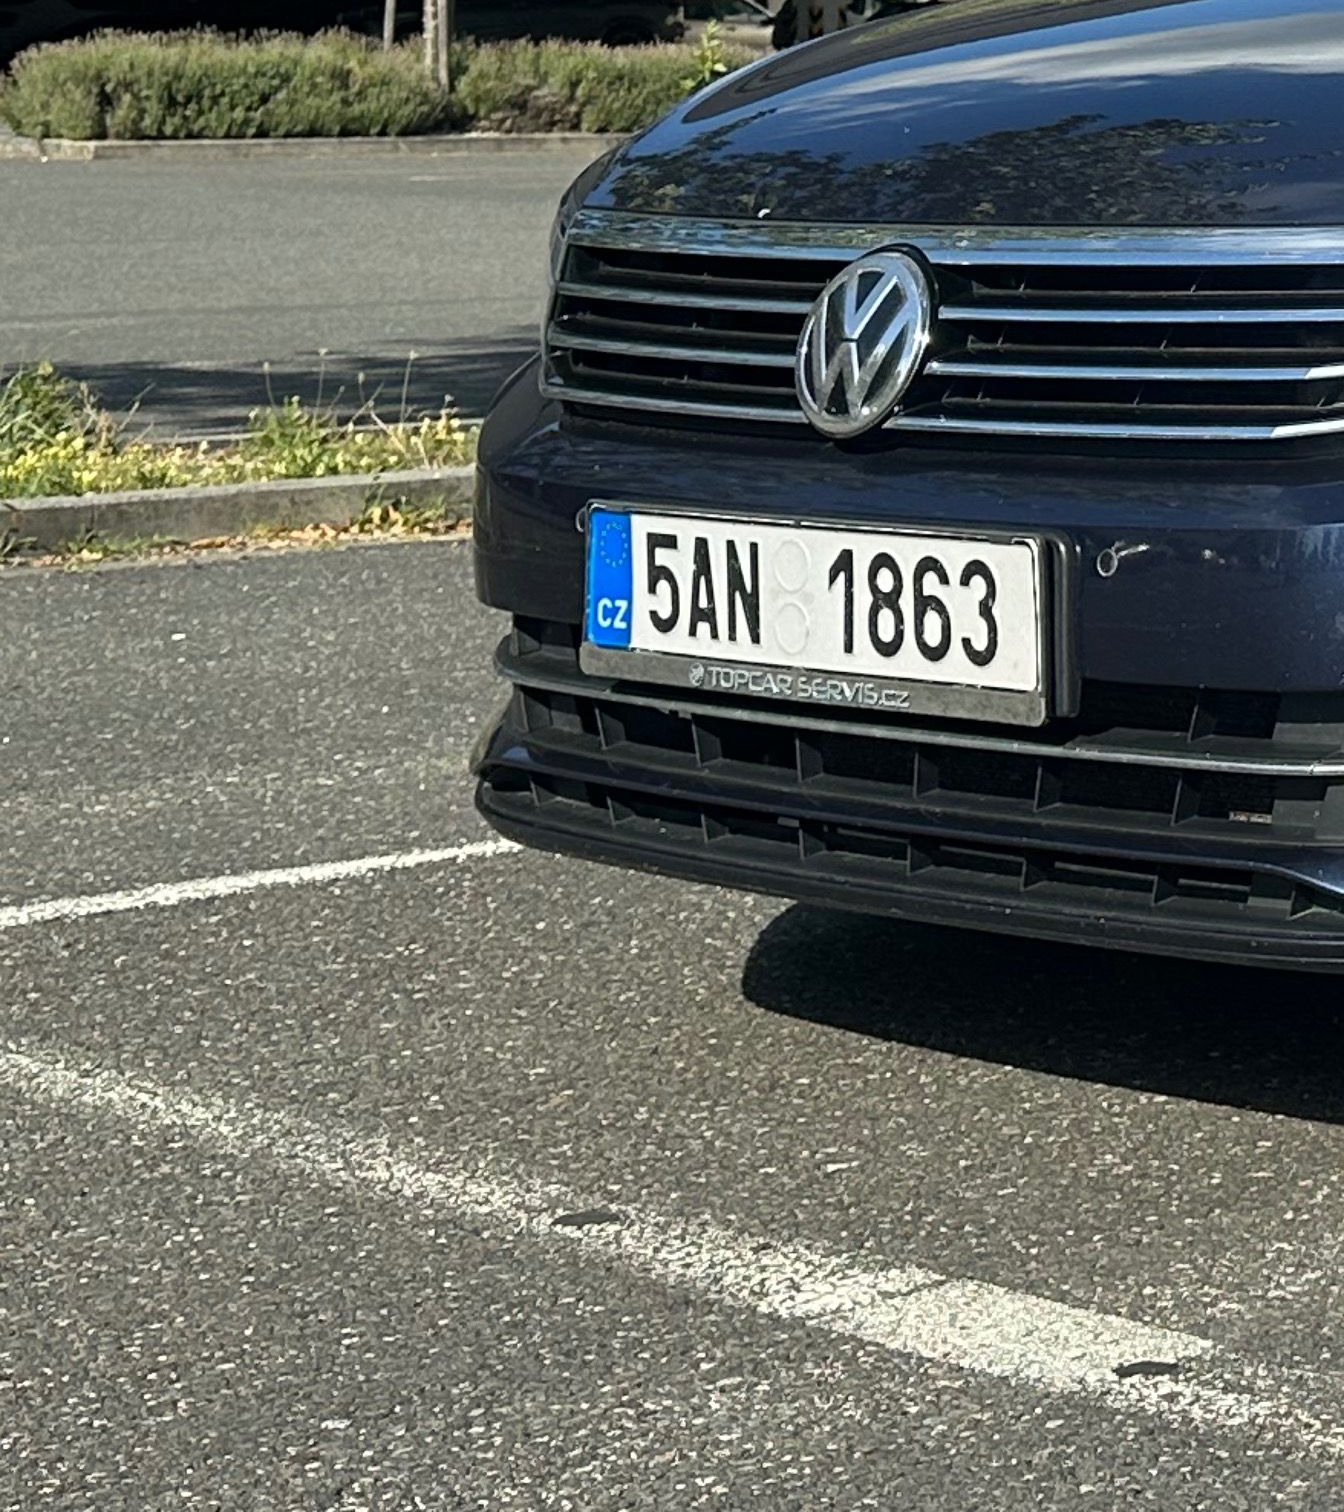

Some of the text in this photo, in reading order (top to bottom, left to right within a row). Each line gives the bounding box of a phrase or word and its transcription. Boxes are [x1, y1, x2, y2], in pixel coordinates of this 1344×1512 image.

[597, 597, 629, 629] CZ
[645, 531, 1000, 666] 5AN 1863
